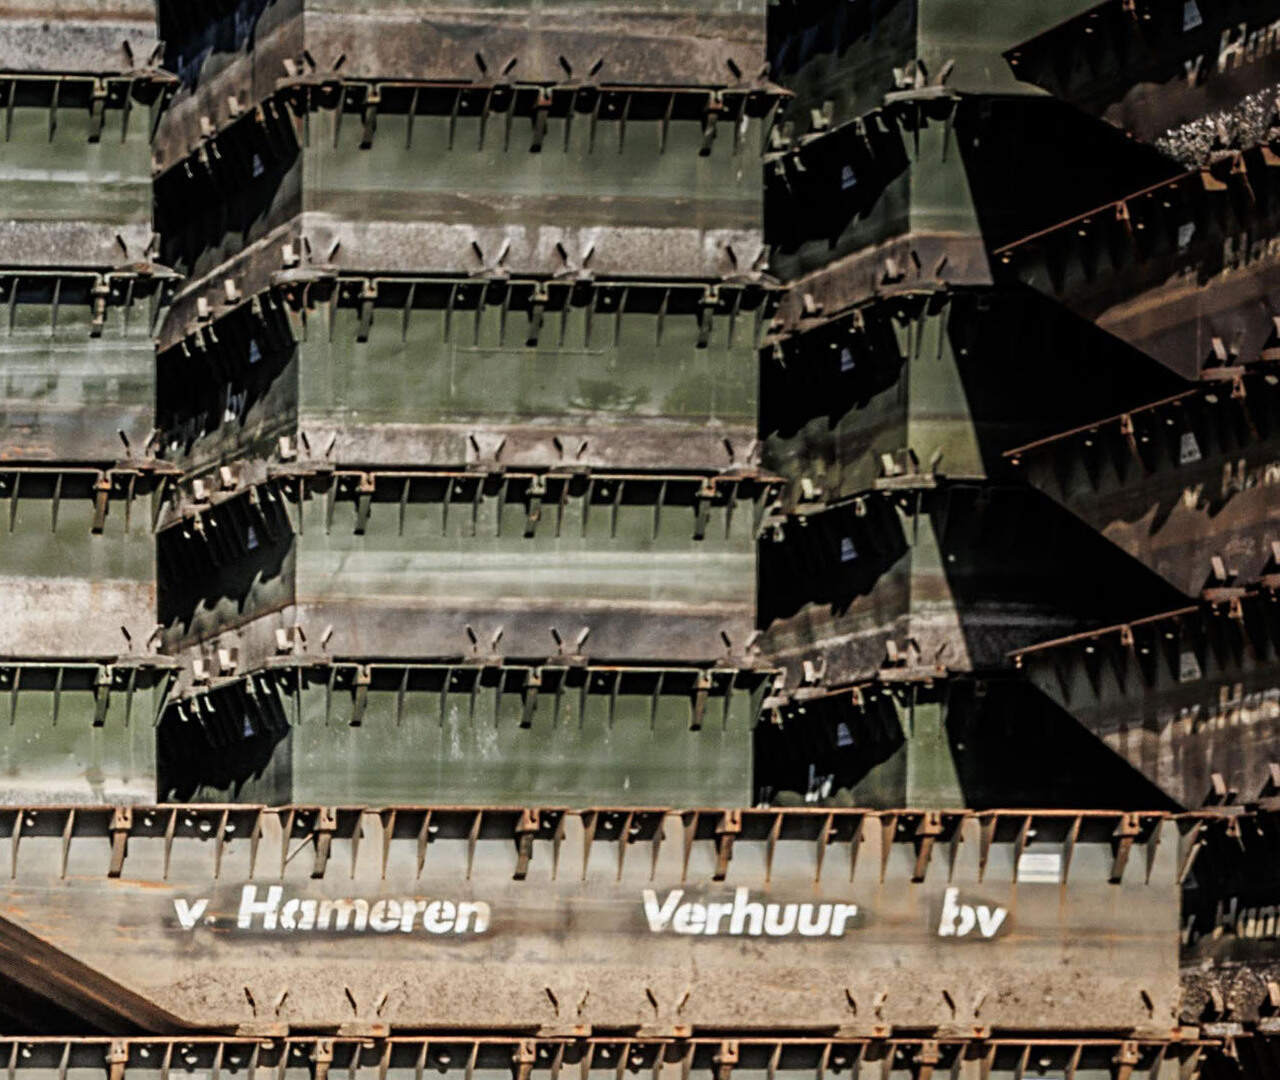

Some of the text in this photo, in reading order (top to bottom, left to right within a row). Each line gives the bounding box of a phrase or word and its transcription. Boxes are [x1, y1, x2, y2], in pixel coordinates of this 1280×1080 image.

[237, 884, 491, 934] Hameren
[642, 887, 859, 936] Verhuur
[939, 887, 1009, 938] bv
